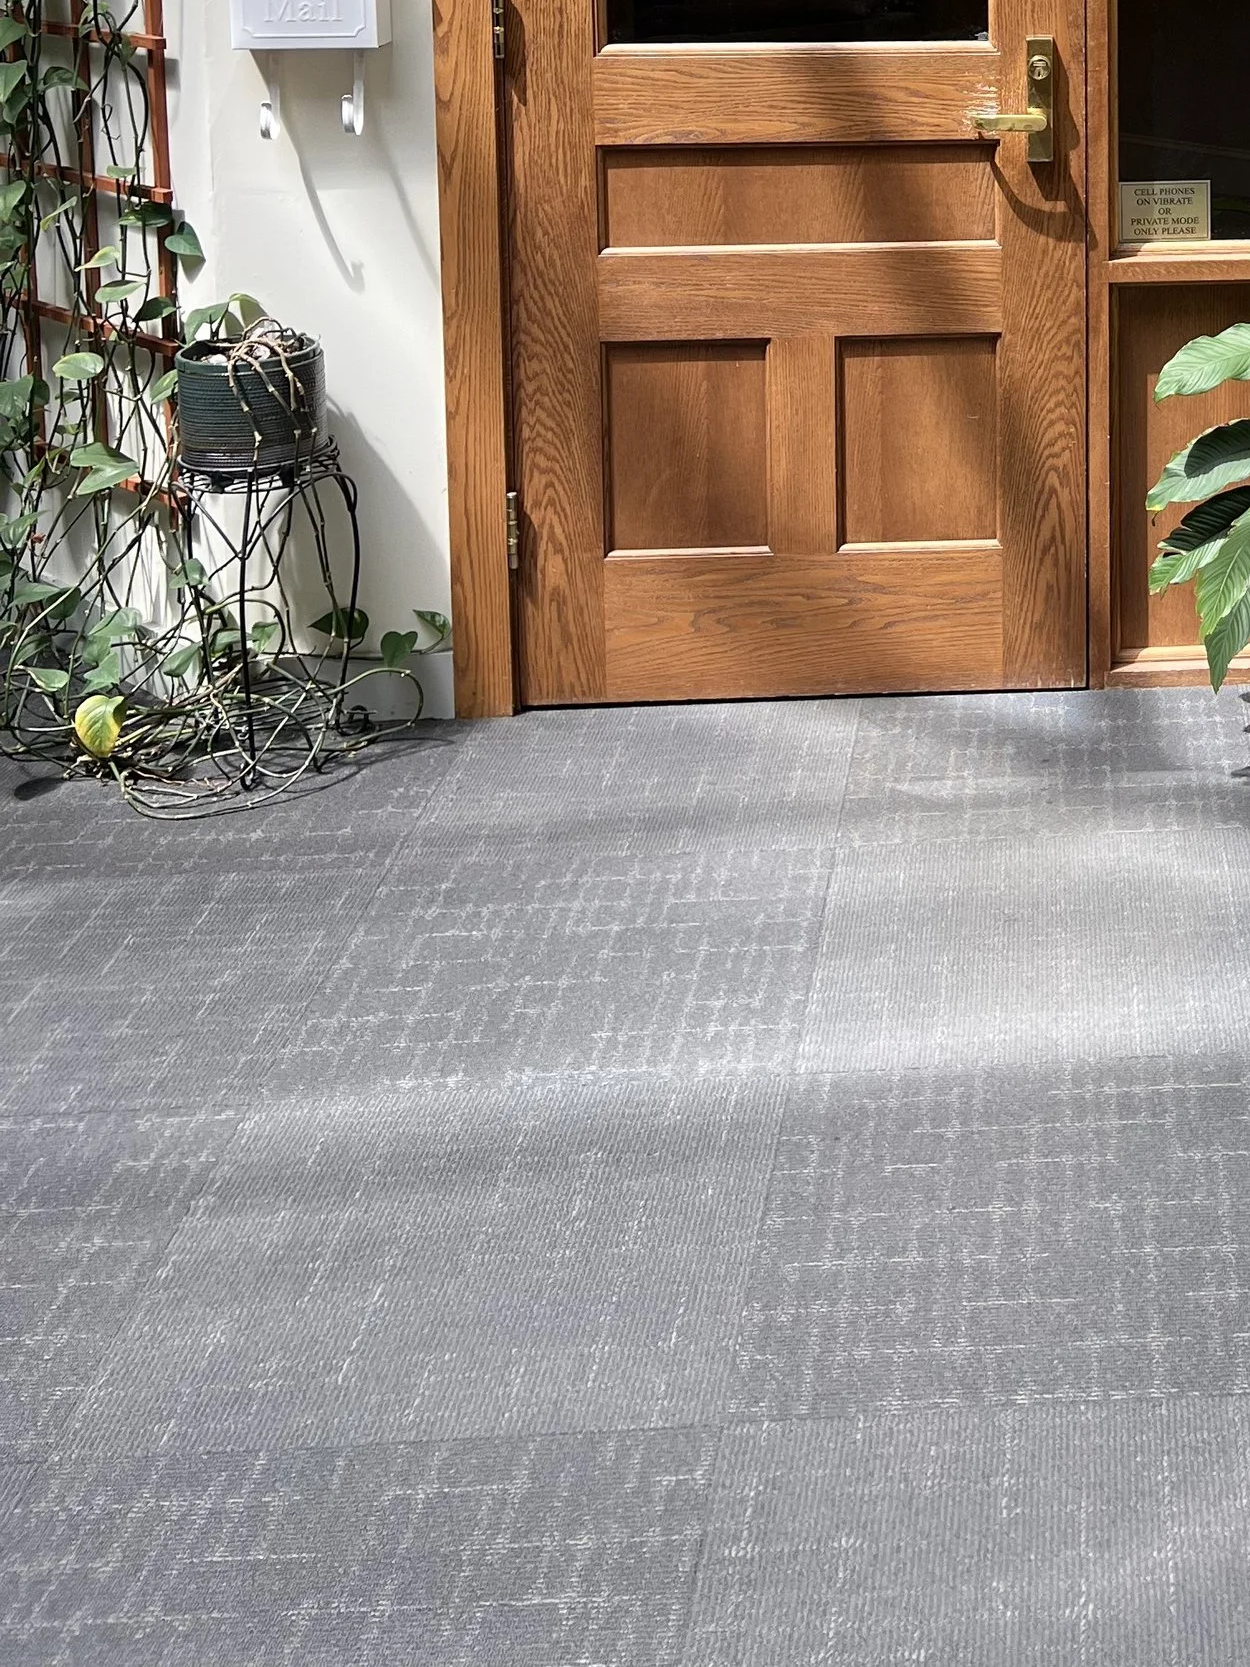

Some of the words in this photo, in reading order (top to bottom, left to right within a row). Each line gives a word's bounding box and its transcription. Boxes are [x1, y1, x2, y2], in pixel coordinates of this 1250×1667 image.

[1134, 188, 1157, 196] CELL
[1159, 187, 1195, 196] PHONES
[1136, 198, 1150, 206] ON
[1153, 197, 1194, 205] VIBRATE
[1158, 207, 1172, 215] OR
[1131, 217, 1169, 226] PRIVATE
[1171, 216, 1200, 225] MODE
[1134, 227, 1159, 236] ONLY
[1161, 226, 1197, 235] PLEASE
